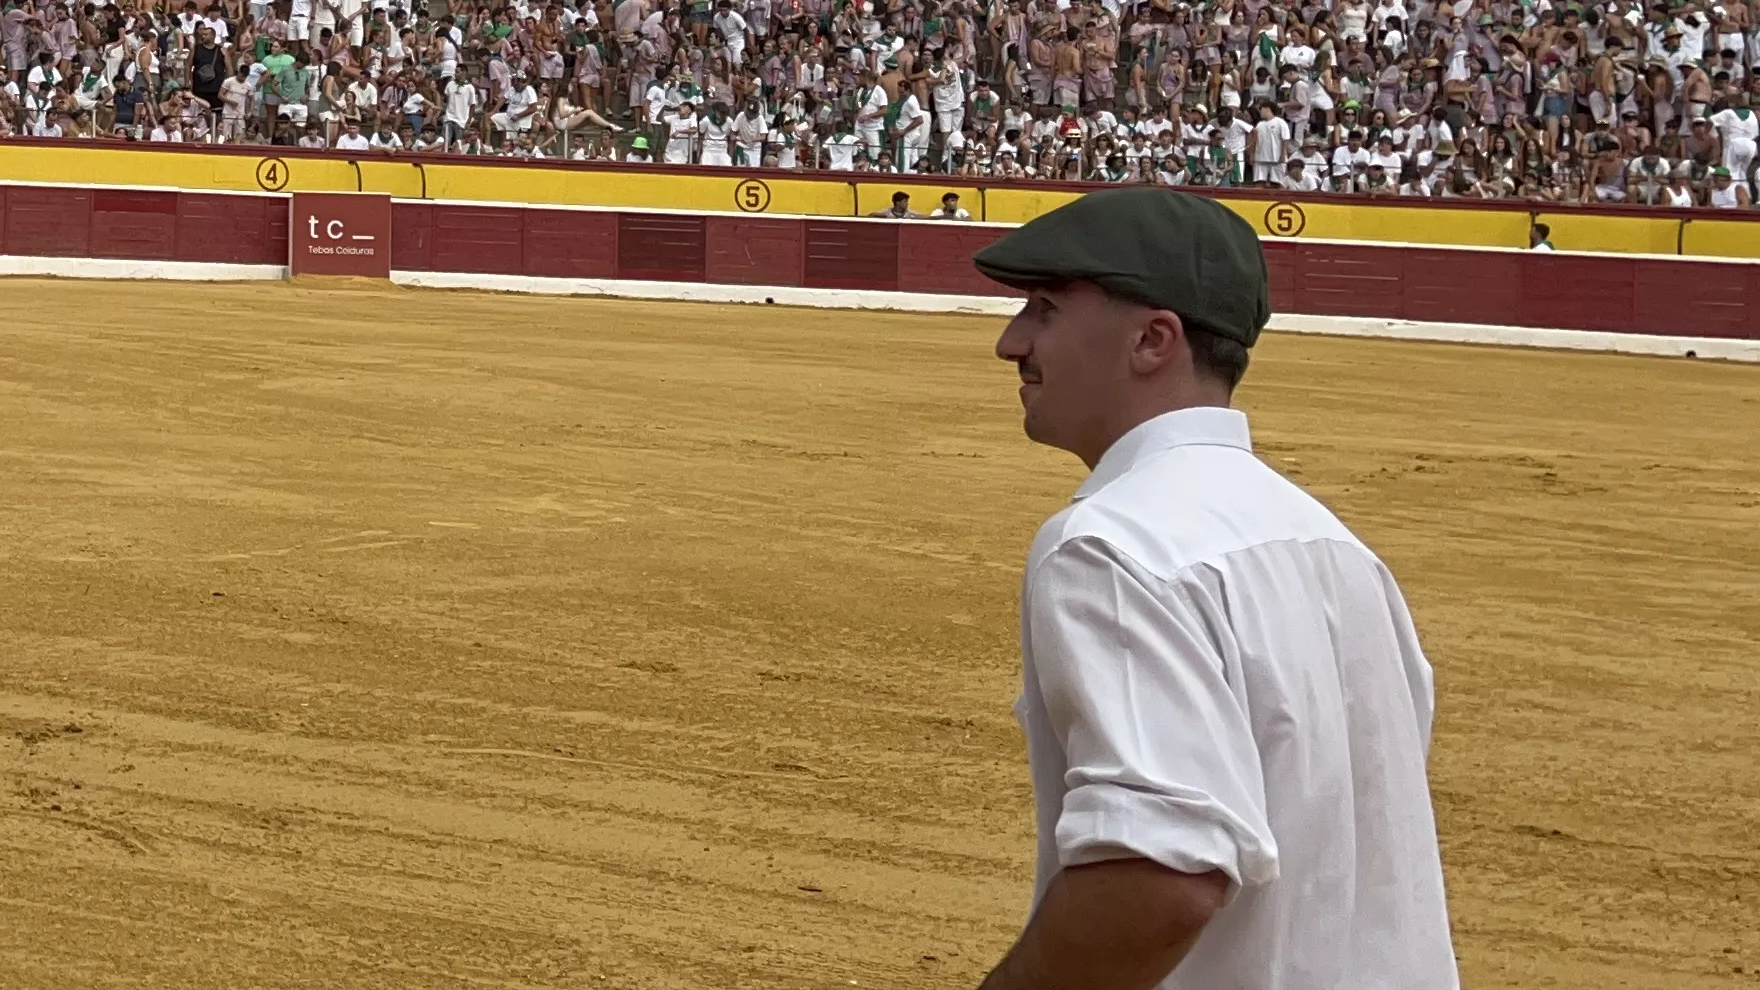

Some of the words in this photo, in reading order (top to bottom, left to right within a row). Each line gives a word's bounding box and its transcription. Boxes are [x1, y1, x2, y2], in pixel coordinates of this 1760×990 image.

[265, 163, 277, 184] 4
[745, 186, 760, 207] 5
[1277, 208, 1293, 232] 5
[308, 245, 334, 254] Tebas
